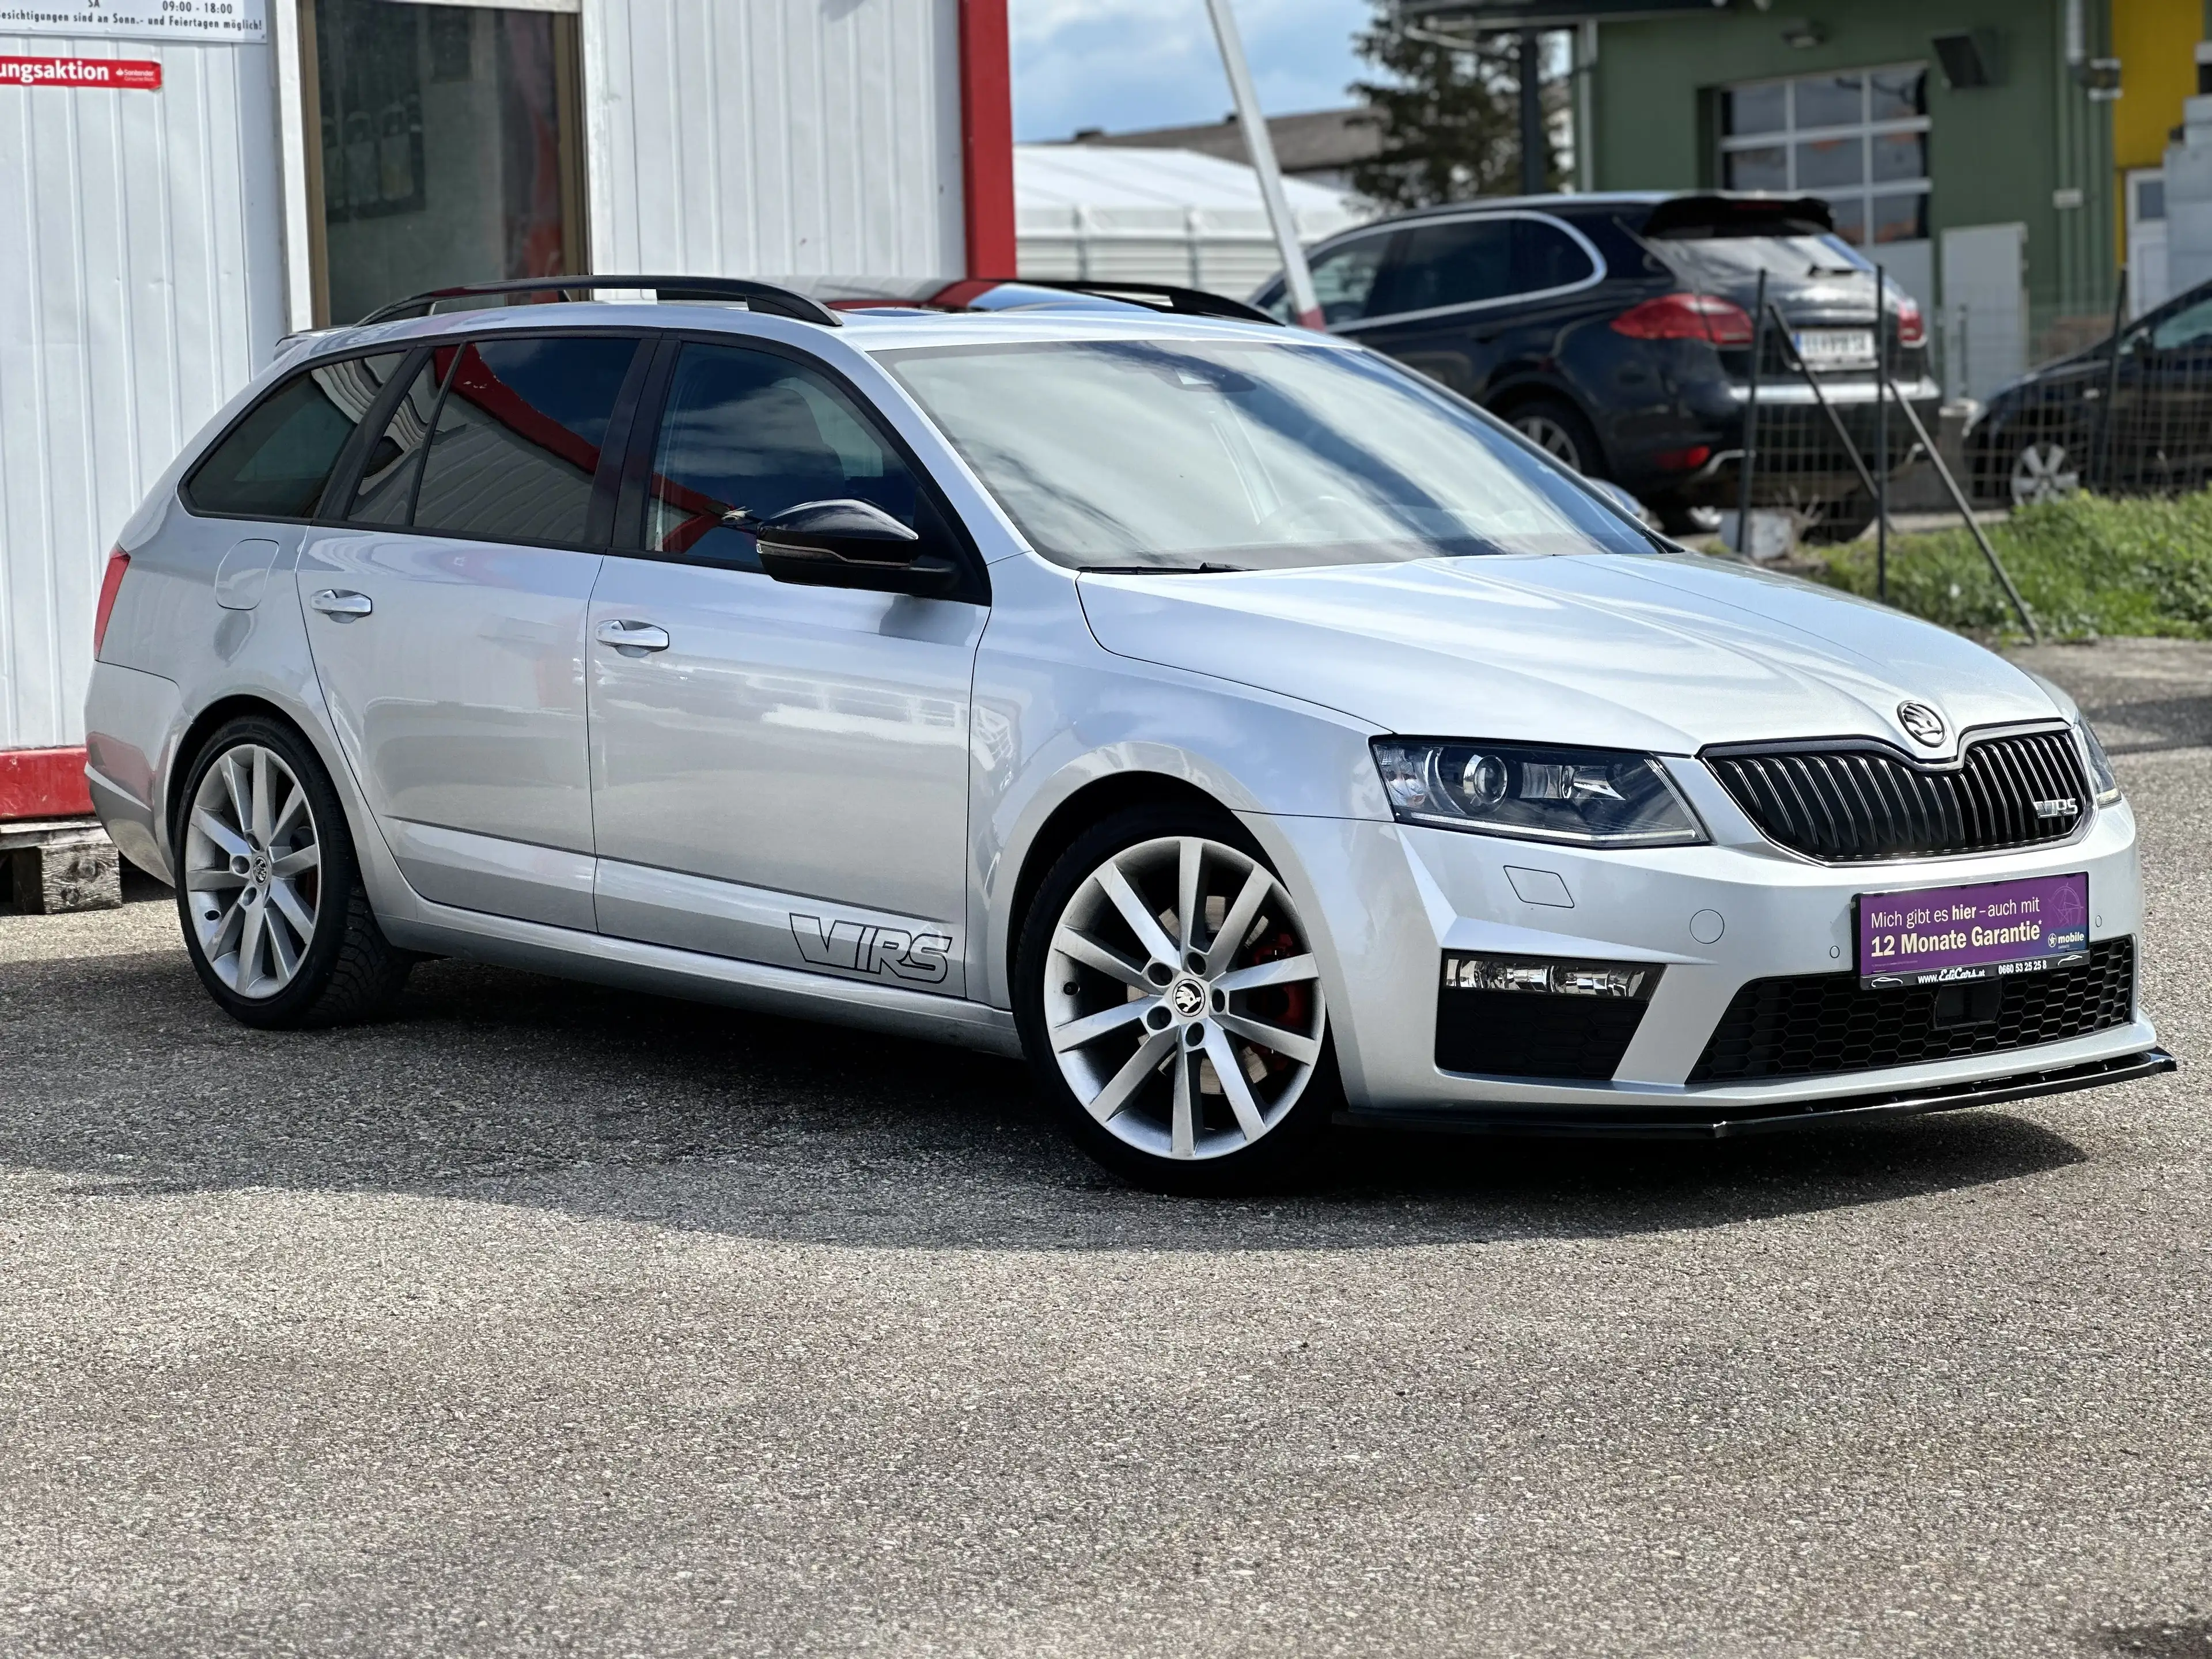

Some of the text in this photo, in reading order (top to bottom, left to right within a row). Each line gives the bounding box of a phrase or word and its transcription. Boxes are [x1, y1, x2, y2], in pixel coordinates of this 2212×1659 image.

[162, 1, 191, 12] 09:00
[204, 3, 232, 14] 18:00
[0, 9, 69, 23] esichtigungen
[73, 12, 93, 22] sind
[97, 15, 108, 23] an
[148, 15, 164, 25] und
[169, 16, 219, 29] Feiertagen
[224, 19, 262, 31] möglich!
[1871, 910, 1902, 929] Mich
[1906, 908, 1931, 929] gibt
[1934, 908, 1949, 923] es
[1952, 904, 1977, 921] hier
[1988, 899, 2017, 917] auch
[2021, 896, 2040, 914] mit
[1871, 935, 1895, 957] 12
[1901, 929, 1967, 955] Monate
[2058, 931, 2085, 944] mobile
[1998, 960, 2047, 975] 0660 53 25 25 8
